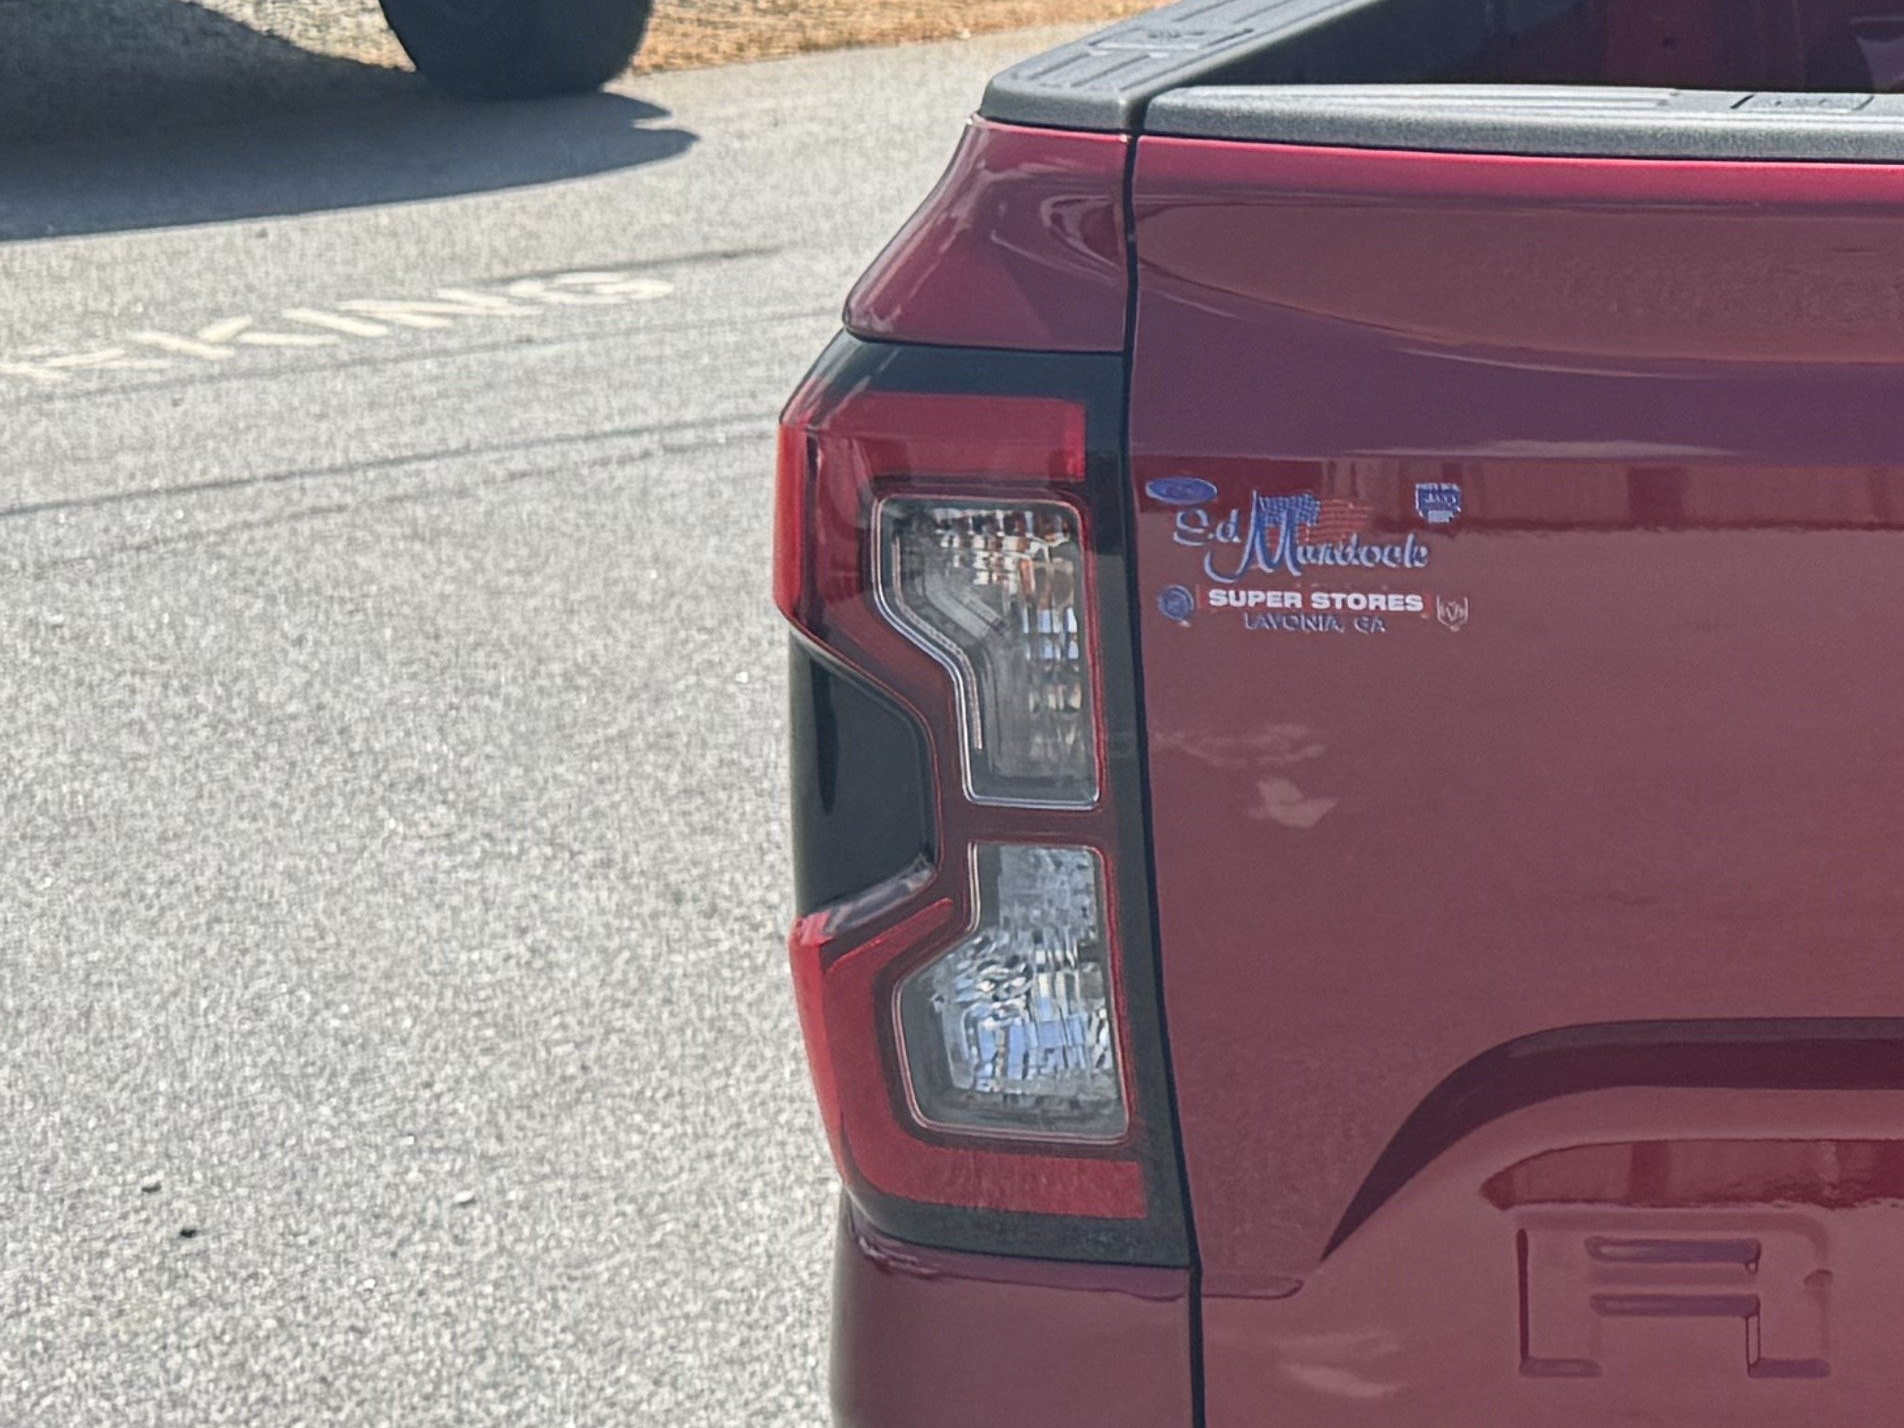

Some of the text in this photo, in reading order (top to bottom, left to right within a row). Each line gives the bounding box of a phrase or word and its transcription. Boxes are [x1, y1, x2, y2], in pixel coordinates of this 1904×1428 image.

[1173, 508, 1241, 548] Ed
[1204, 490, 1429, 584] Murdock
[1208, 588, 1424, 613] SUPER STORES
[1353, 617, 1387, 635] GA
